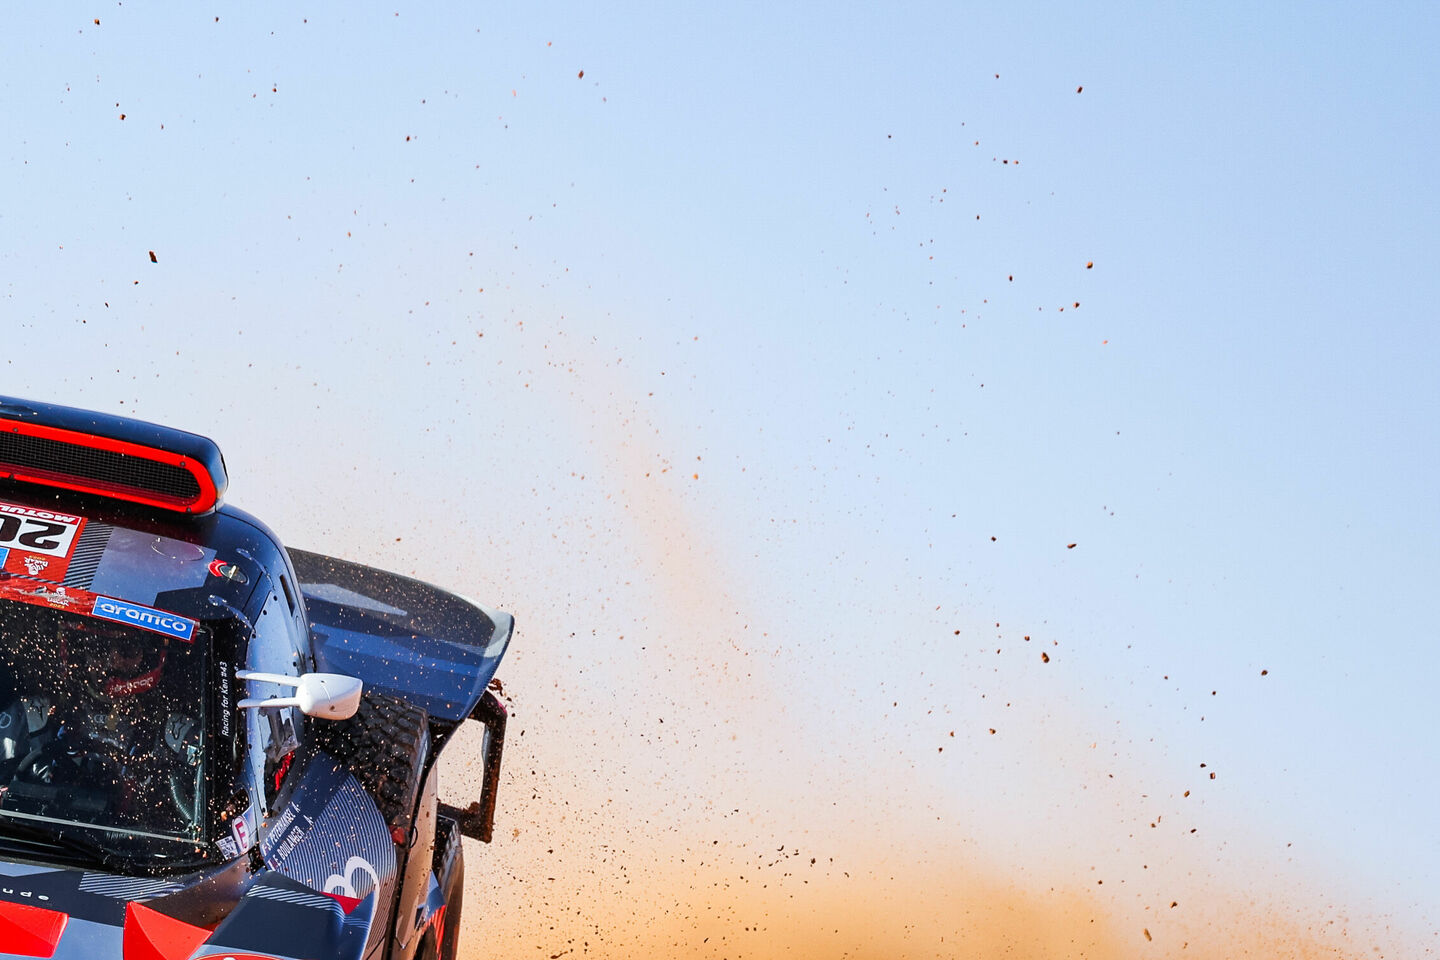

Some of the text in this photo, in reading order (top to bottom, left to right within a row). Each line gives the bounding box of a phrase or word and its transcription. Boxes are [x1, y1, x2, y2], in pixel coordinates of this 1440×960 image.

[0, 505, 76, 523] MOTUL
[100, 603, 187, 632] aramco
[221, 679, 229, 694] Ken
[221, 695, 229, 708] for
[221, 709, 231, 736] Racing
[277, 825, 305, 860] BOULANGER
